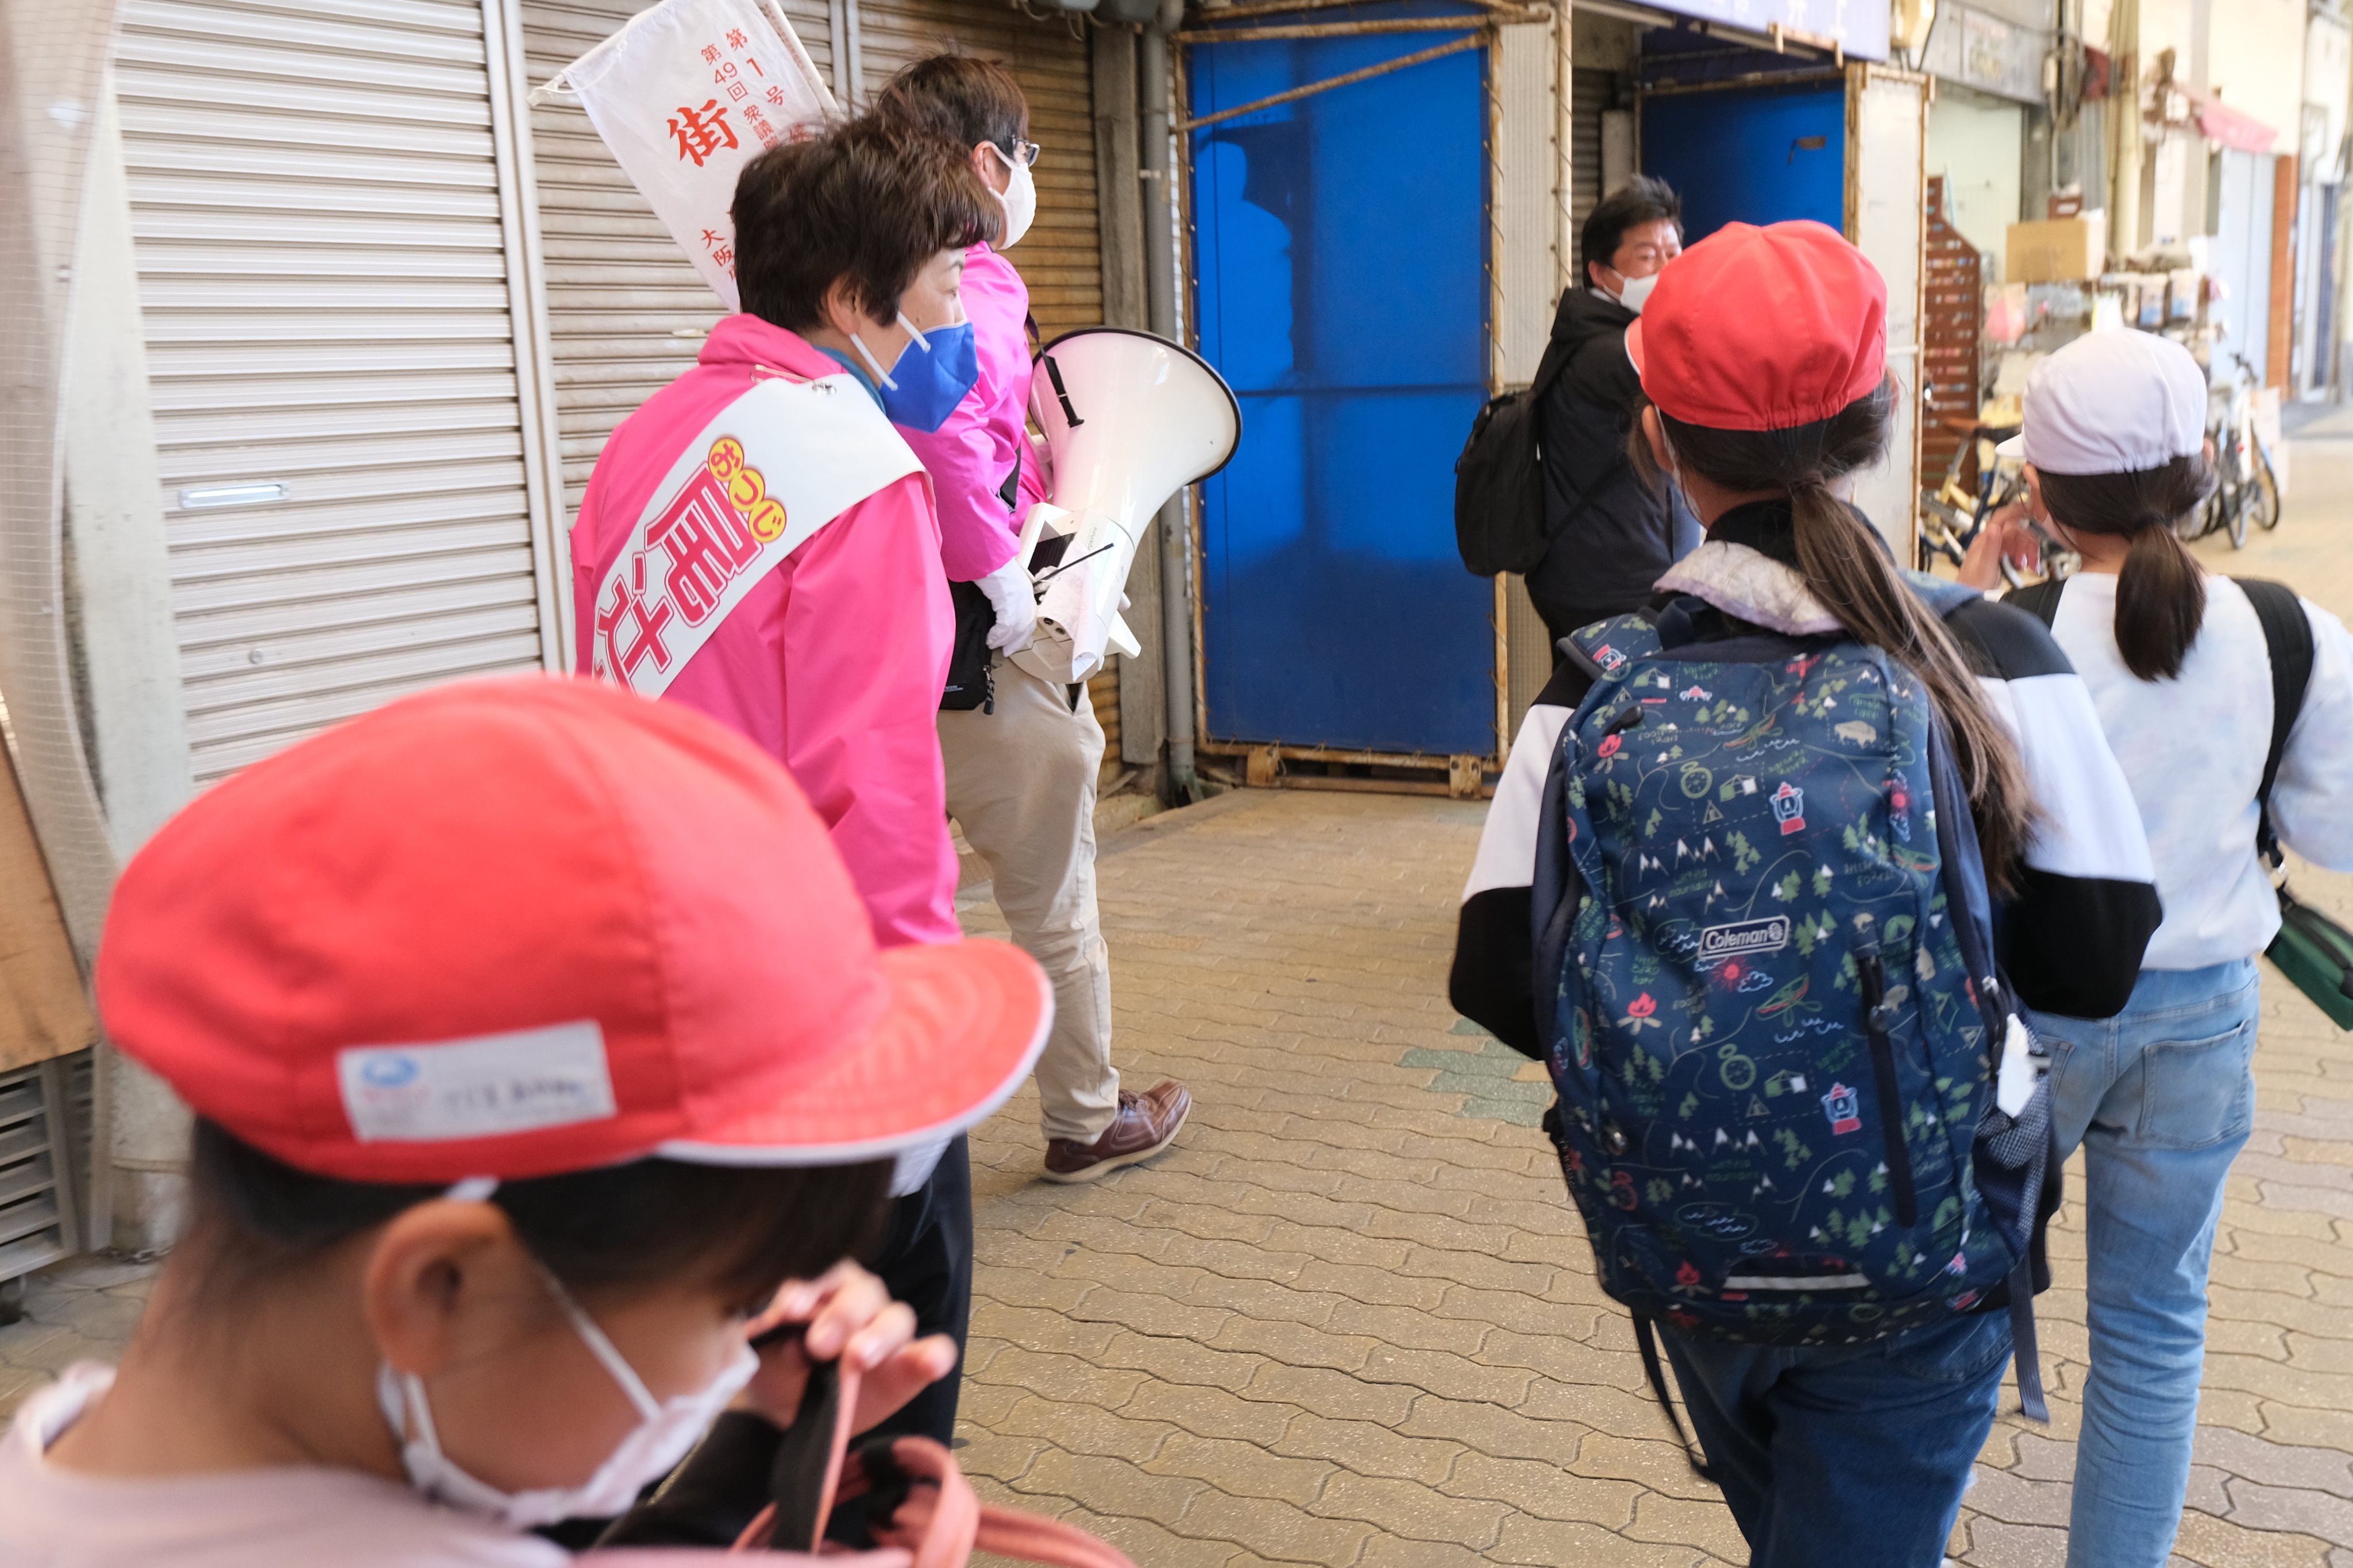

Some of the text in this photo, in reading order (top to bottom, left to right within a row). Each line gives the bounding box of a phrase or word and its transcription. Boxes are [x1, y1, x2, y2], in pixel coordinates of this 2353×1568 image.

[726, 28, 785, 106] 第1号
[666, 99, 739, 167] 街
[709, 440, 784, 540] おつじ
[1705, 928, 1768, 949] Coleman
